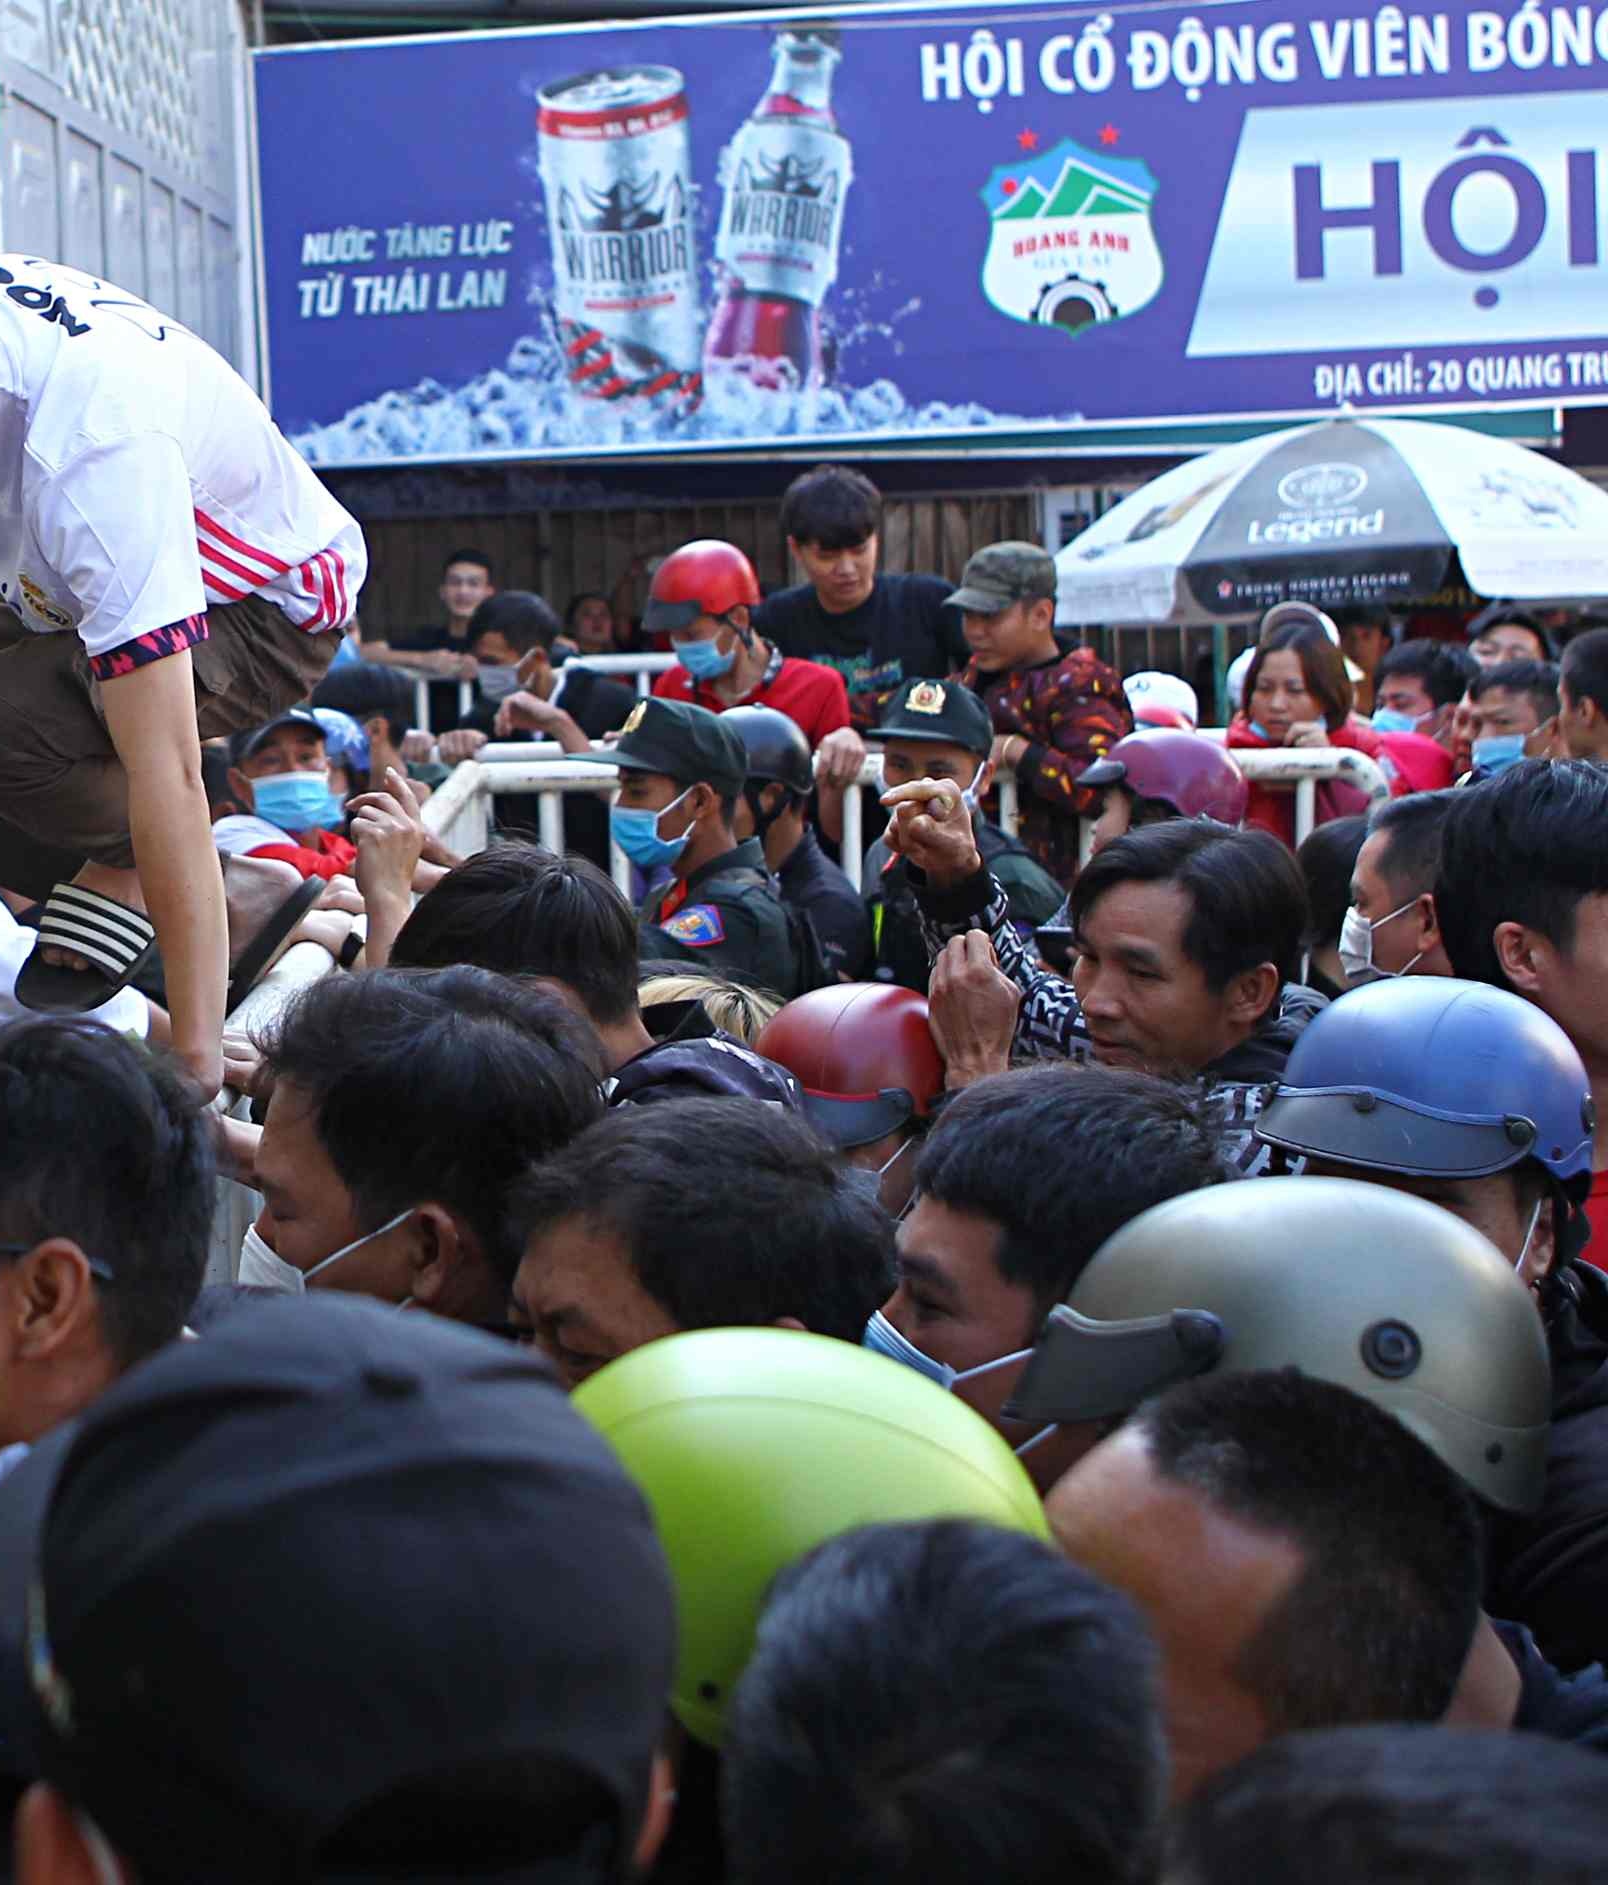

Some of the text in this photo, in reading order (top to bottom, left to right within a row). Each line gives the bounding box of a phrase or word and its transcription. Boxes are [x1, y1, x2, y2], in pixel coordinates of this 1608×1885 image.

[920, 30, 1024, 114] HỘI
[1039, 13, 1115, 94] CỔ
[1127, 18, 1297, 102] ĐỘNG
[1310, 8, 1449, 78] VIÊN
[729, 190, 833, 251] WARRIOR
[1292, 126, 1599, 310] HỘI
[562, 222, 690, 284] WARRIOR
[352, 266, 430, 315] THÁI
[437, 268, 506, 311] LAN
[1314, 362, 1363, 404] ĐỊA
[1428, 359, 1463, 394] 20
[1466, 353, 1561, 394] QUANG
[1248, 508, 1384, 544] Legend
